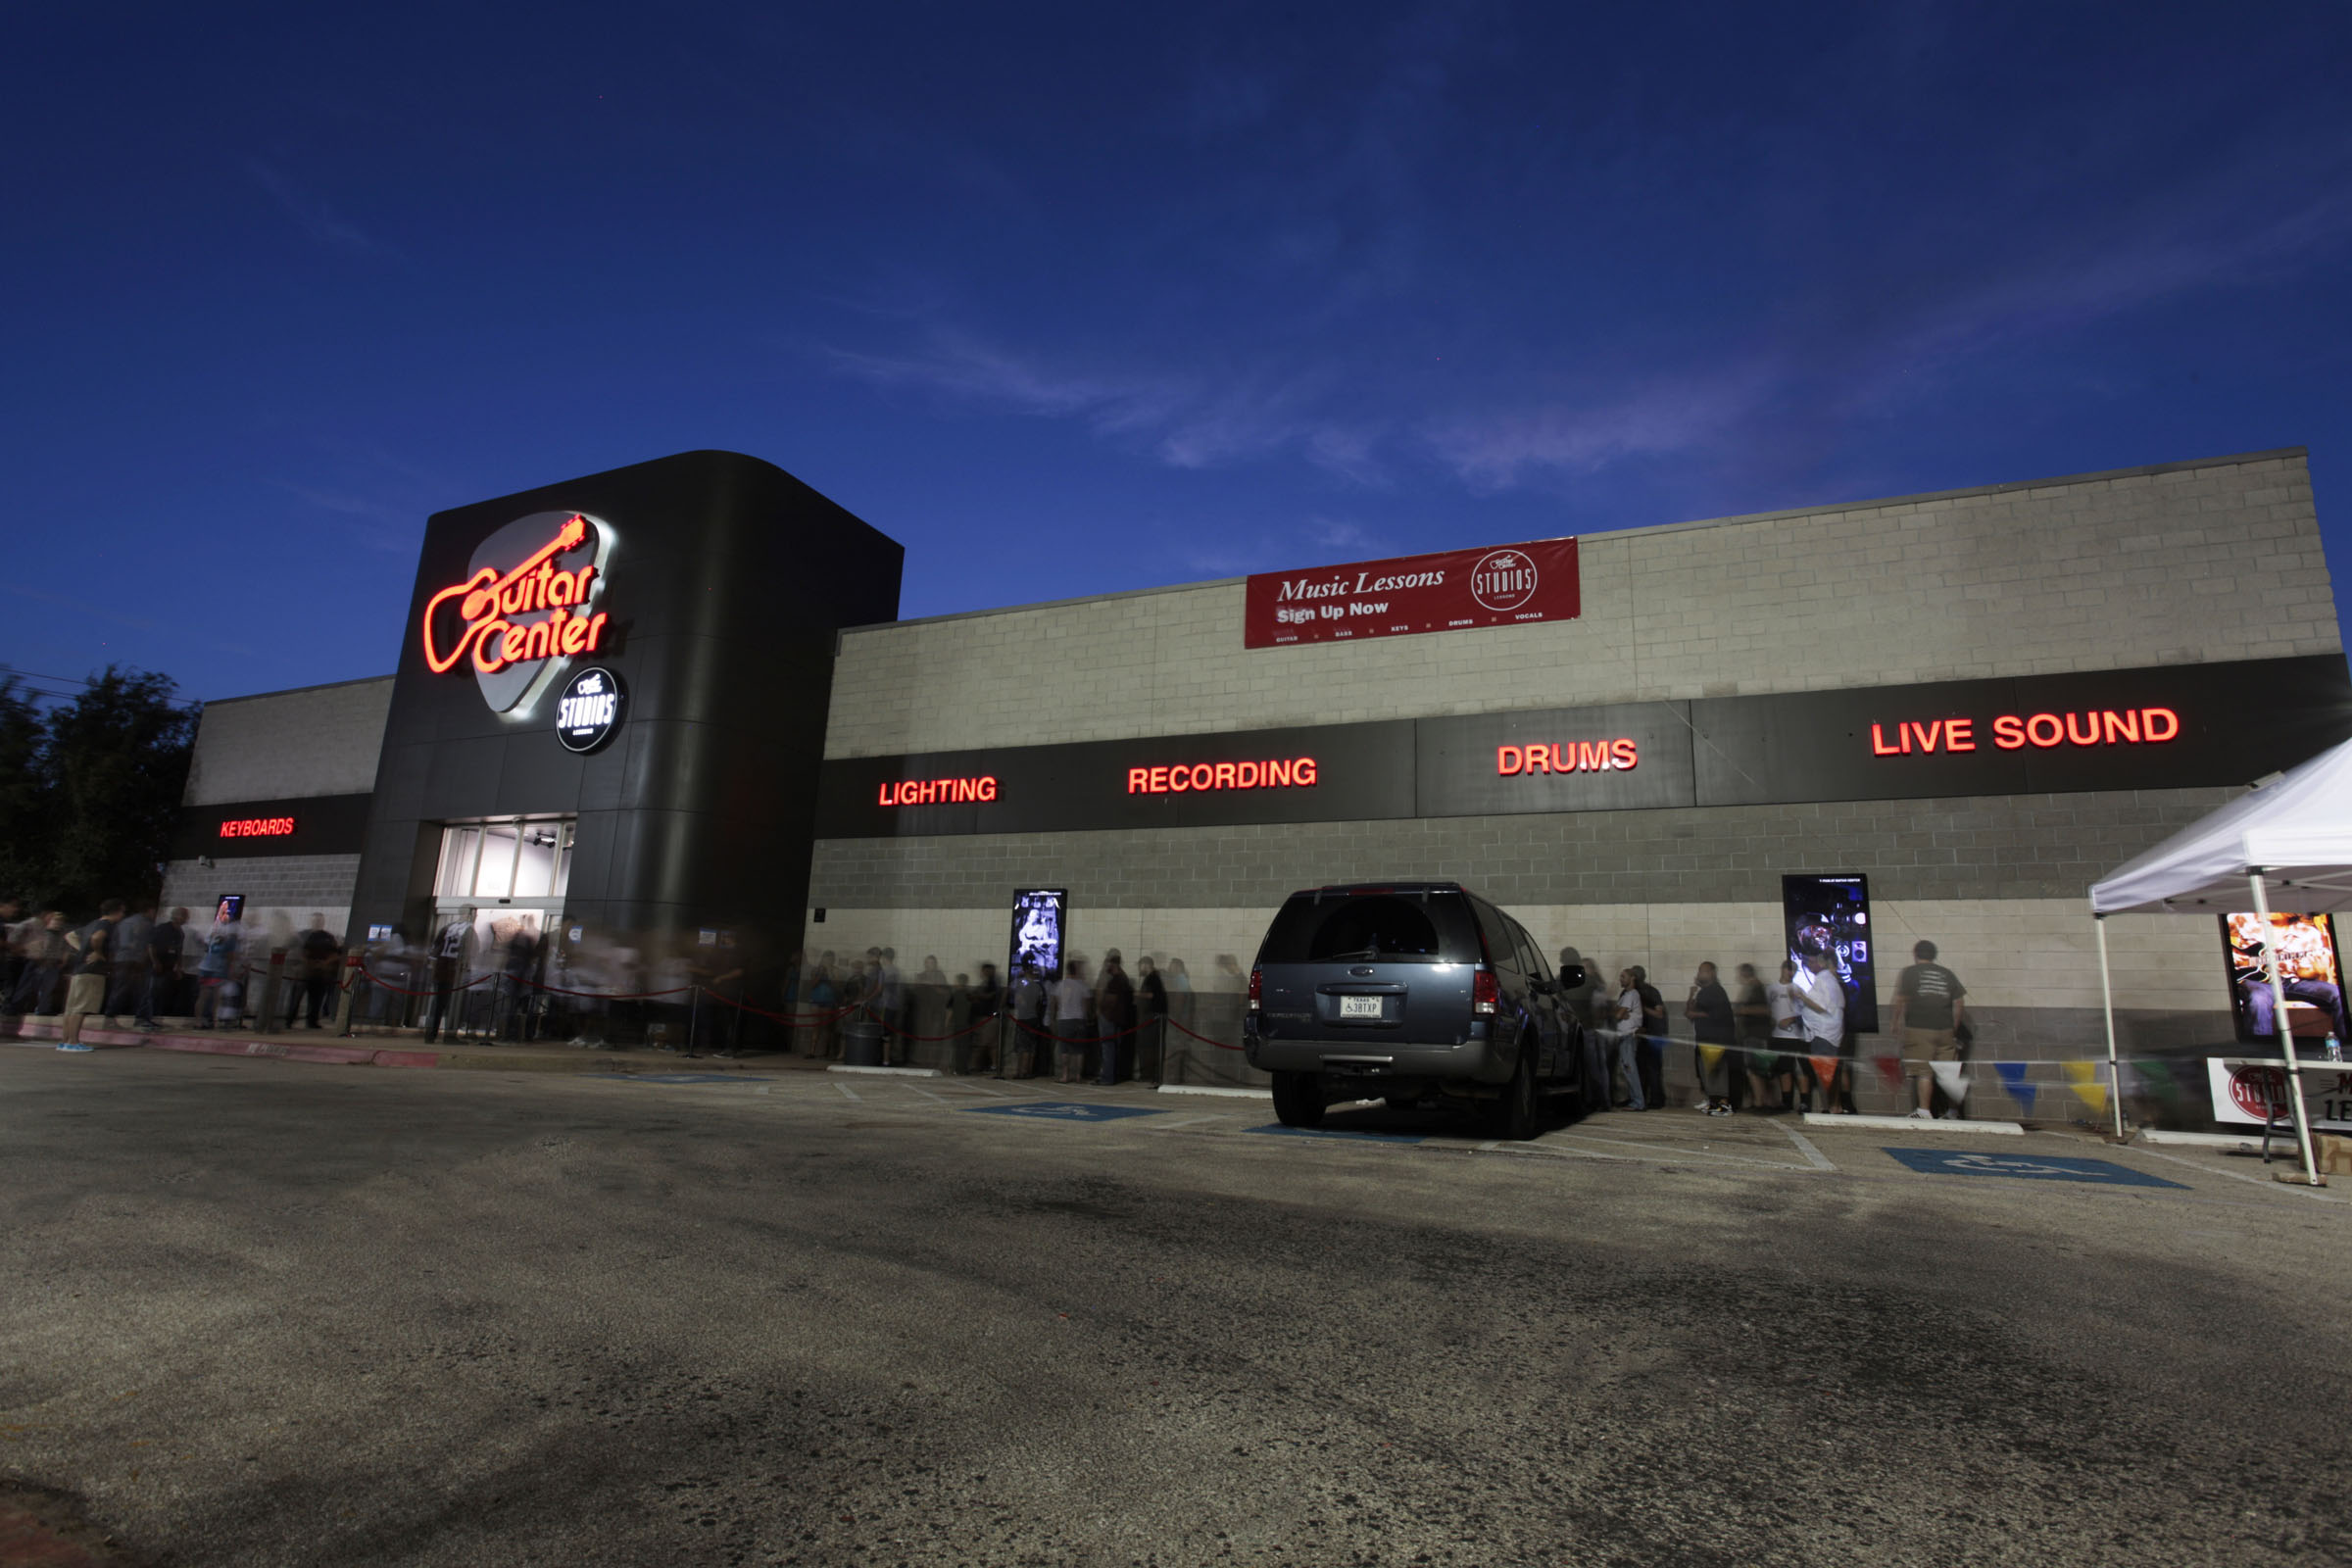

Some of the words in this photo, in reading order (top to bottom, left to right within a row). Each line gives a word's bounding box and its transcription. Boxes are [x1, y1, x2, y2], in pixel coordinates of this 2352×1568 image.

[1276, 575, 1349, 602] Music
[1353, 570, 1445, 594] Lessons
[1477, 568, 1531, 595] STUDIOS
[1277, 609, 1315, 624] Sign
[1320, 605, 1345, 620] Up
[1350, 602, 1389, 615] Now
[1447, 618, 1474, 627] DRUMS
[1514, 612, 1544, 620] VOCALS
[473, 607, 608, 673] Center
[559, 693, 614, 728] STUDIOS
[1871, 718, 1977, 756] LIVE
[1992, 708, 2180, 751] SOUND
[1497, 737, 1639, 775] DRUMS
[878, 775, 997, 807] LIGHTING
[1128, 757, 1317, 794] RECORDING
[220, 816, 295, 838] KEYBOARDS
